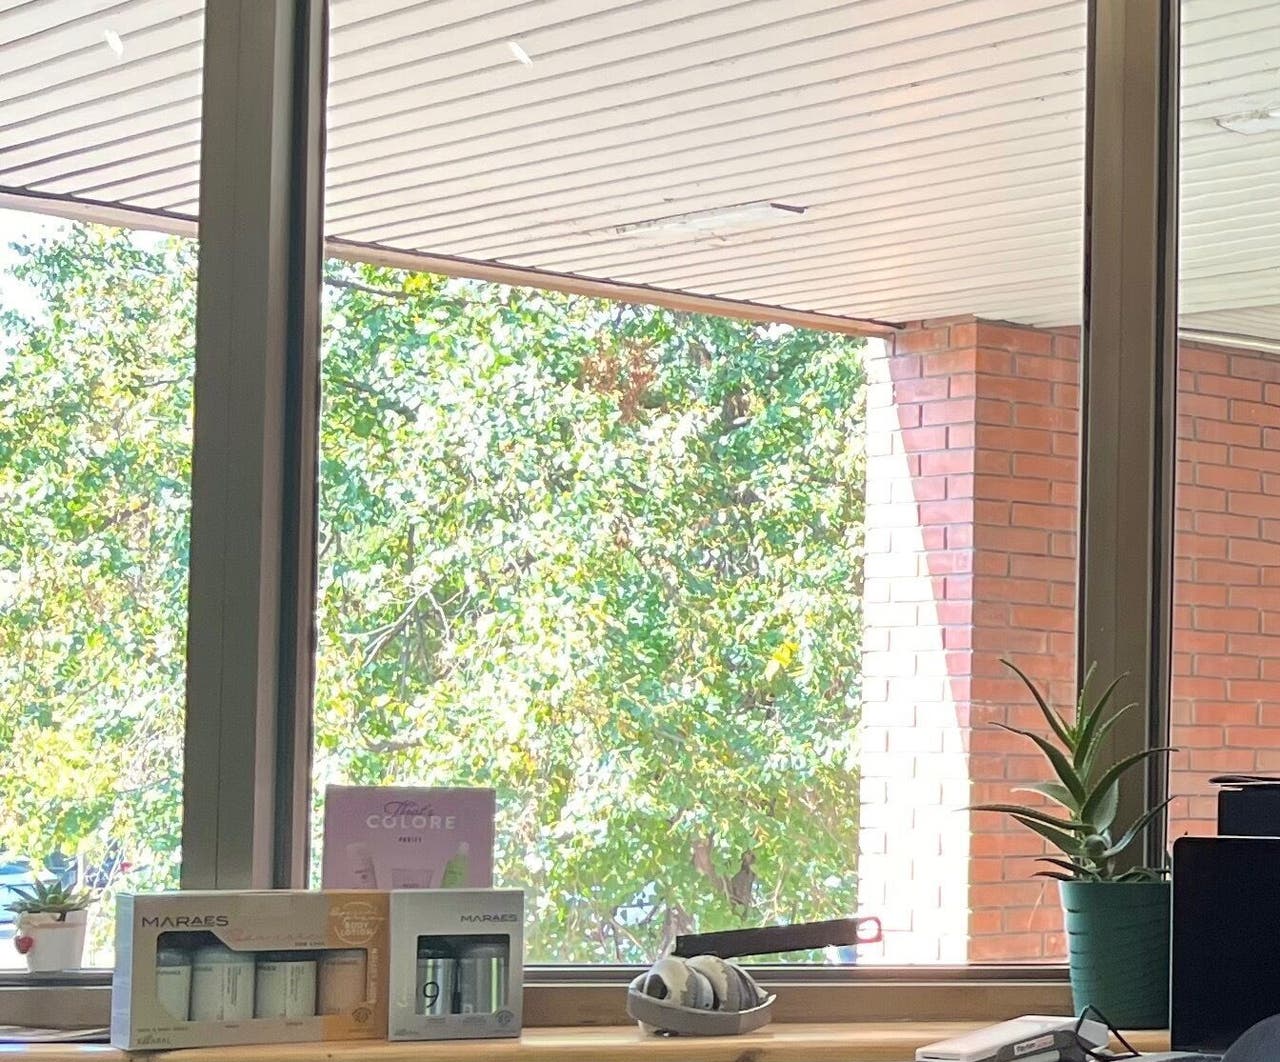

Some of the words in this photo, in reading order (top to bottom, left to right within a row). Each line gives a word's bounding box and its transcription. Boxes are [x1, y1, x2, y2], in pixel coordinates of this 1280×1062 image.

[366, 815, 456, 829] COLORE
[142, 916, 229, 927] MARAES
[461, 914, 517, 922] MARAES
[423, 981, 439, 1008] 9
